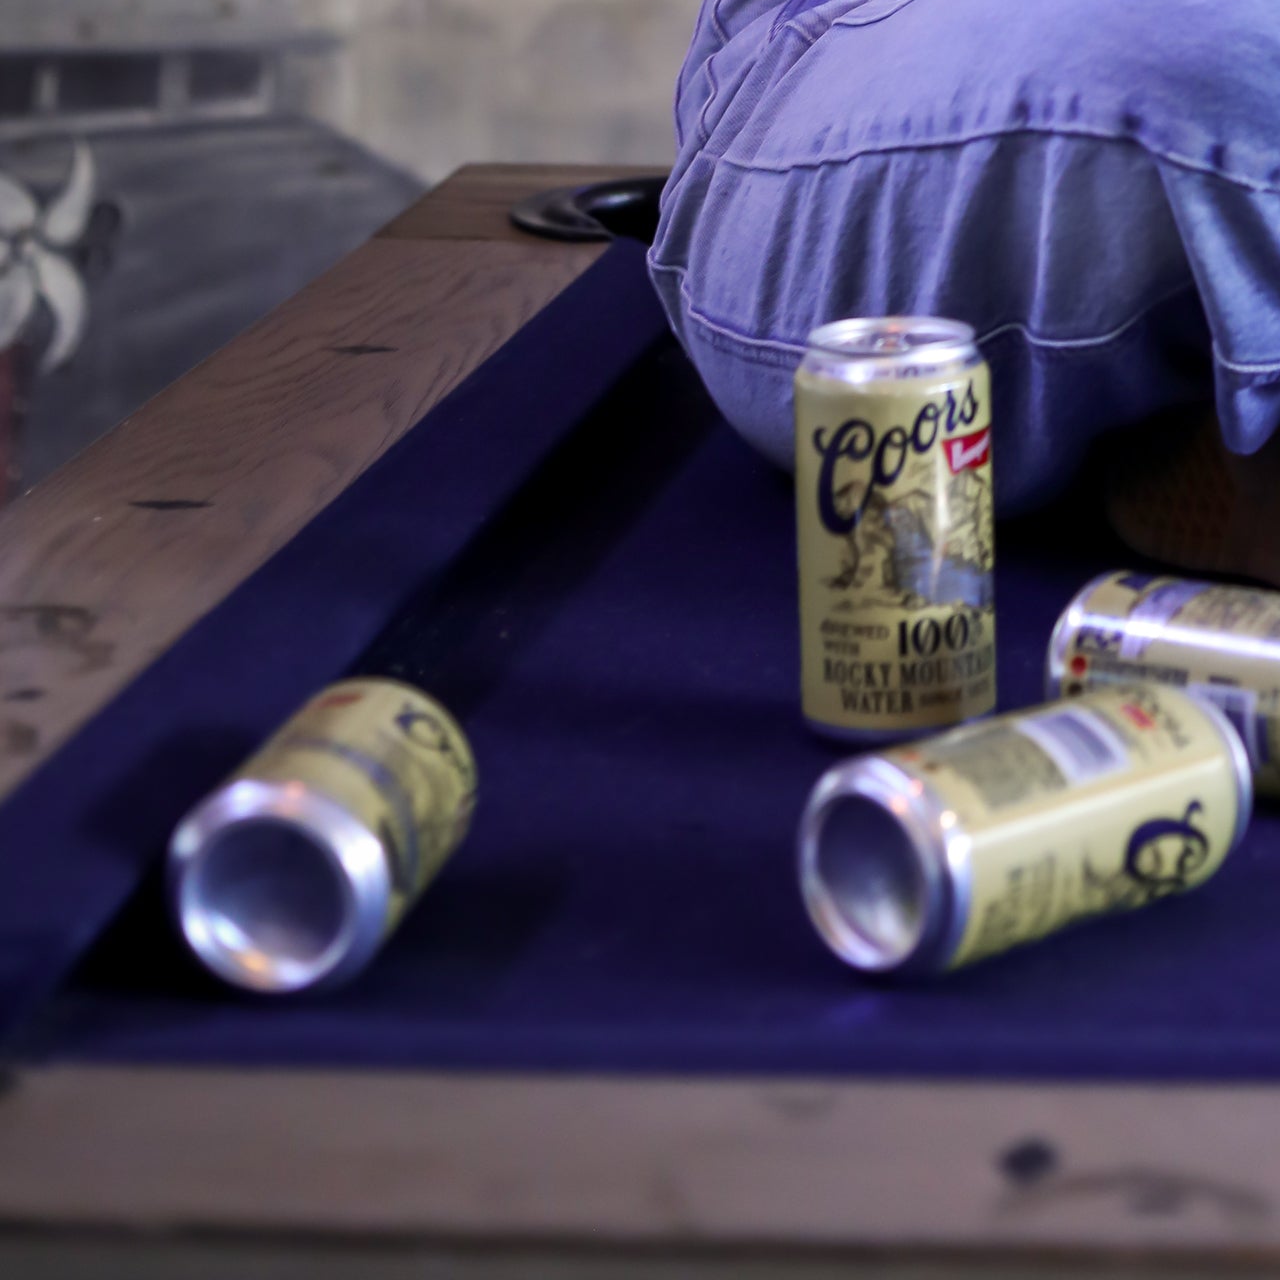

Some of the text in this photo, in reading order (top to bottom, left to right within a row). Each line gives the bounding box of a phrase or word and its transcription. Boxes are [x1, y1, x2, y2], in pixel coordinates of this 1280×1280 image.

[812, 378, 979, 534] Coors
[824, 658, 892, 688] ROCKY
[841, 687, 914, 713] WATER
